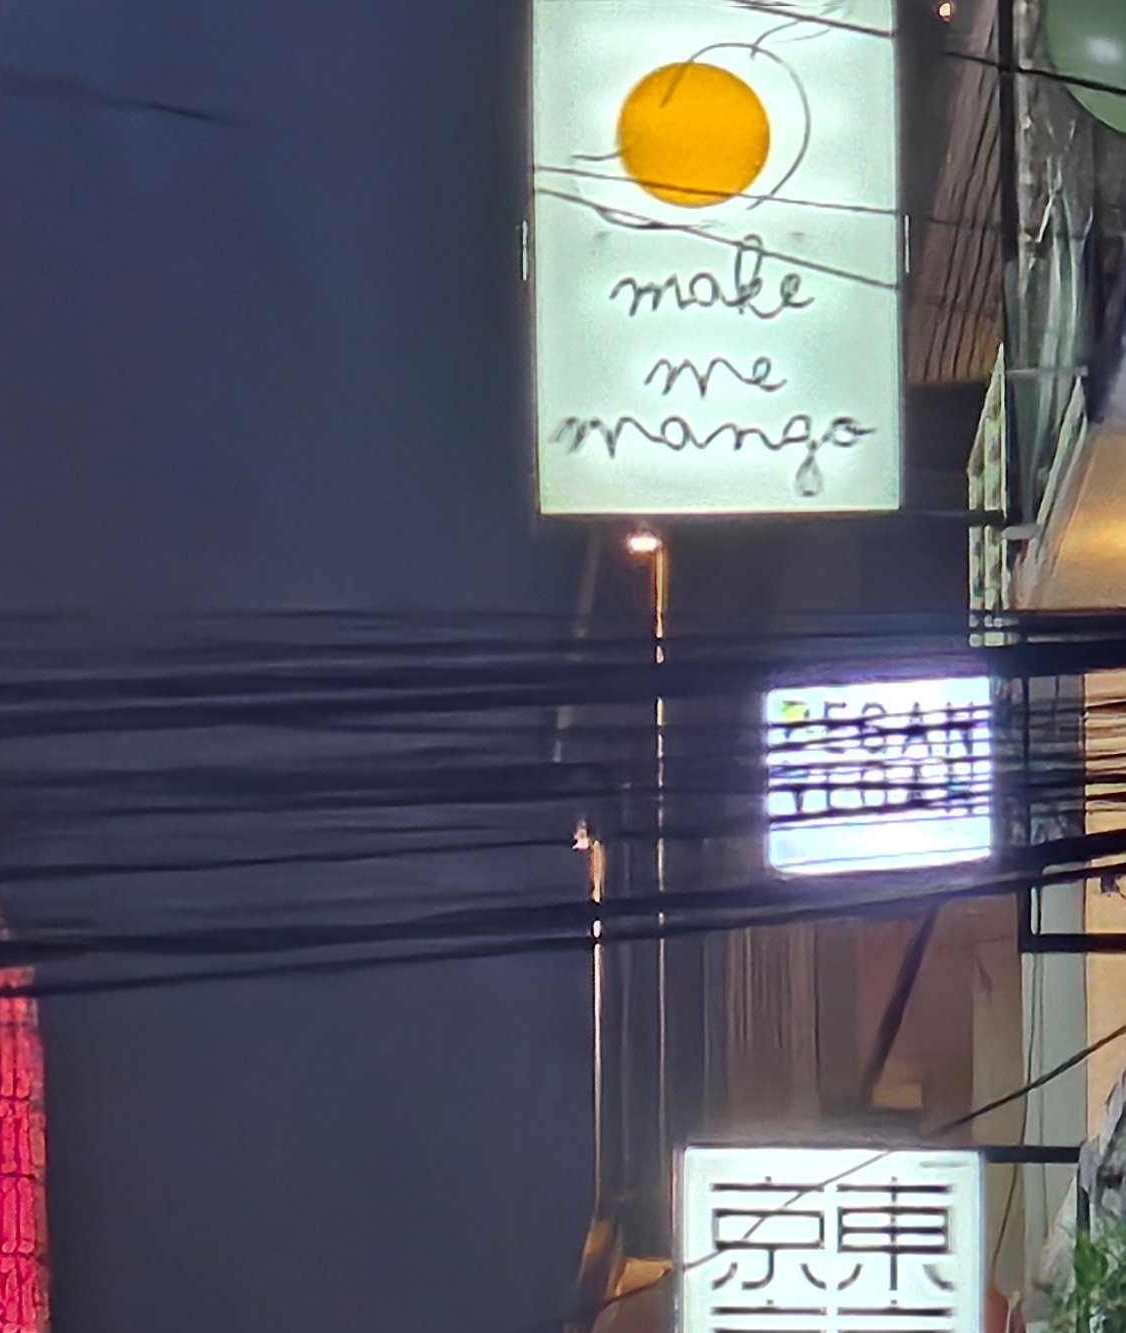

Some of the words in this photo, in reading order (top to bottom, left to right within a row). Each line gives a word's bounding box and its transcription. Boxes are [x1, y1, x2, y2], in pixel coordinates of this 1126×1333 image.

[609, 233, 815, 320] make
[643, 355, 788, 400] me
[548, 413, 877, 498] mango
